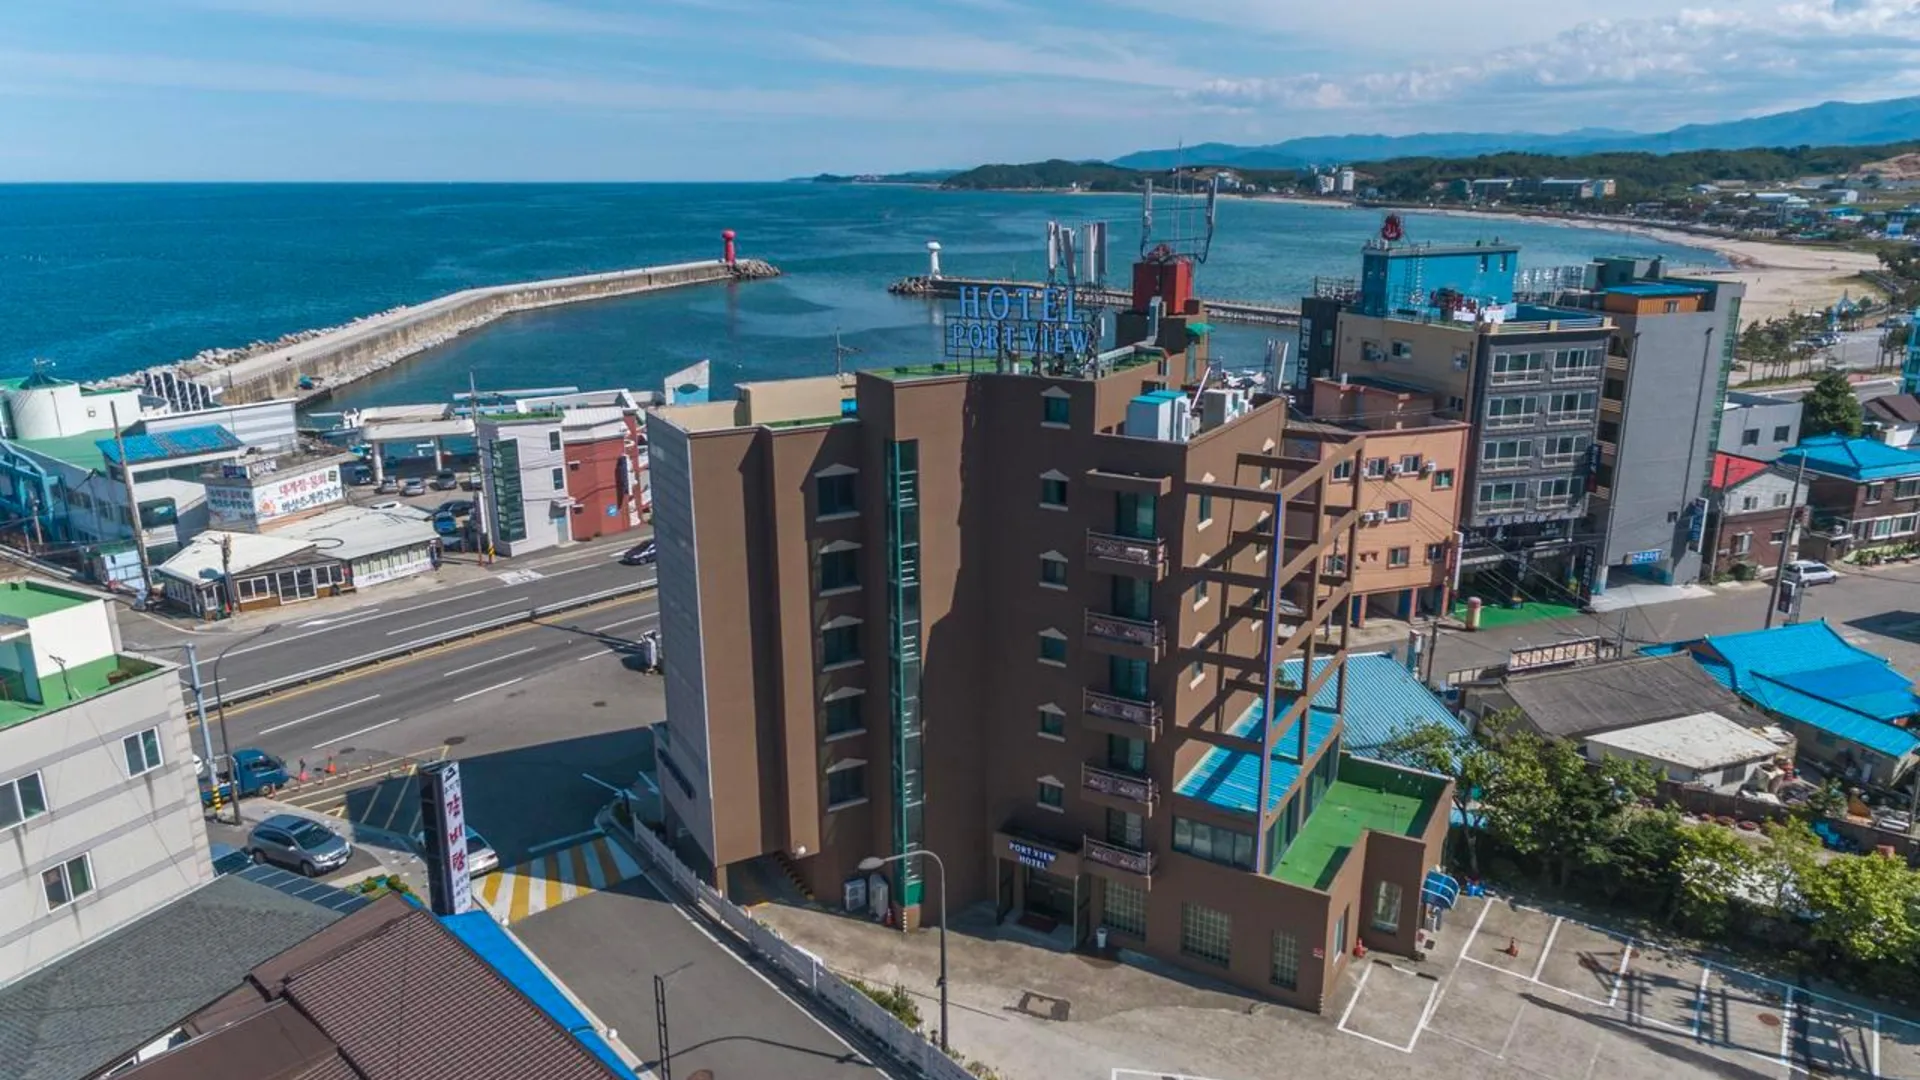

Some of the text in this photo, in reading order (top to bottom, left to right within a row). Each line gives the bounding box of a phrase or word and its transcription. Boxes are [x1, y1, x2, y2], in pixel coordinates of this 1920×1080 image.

[959, 286, 1082, 322] HOTEL
[953, 324, 1091, 354] PORT VIEW
[1008, 842, 1056, 862] PORT VIEW
[1019, 855, 1046, 870] HOTEL
